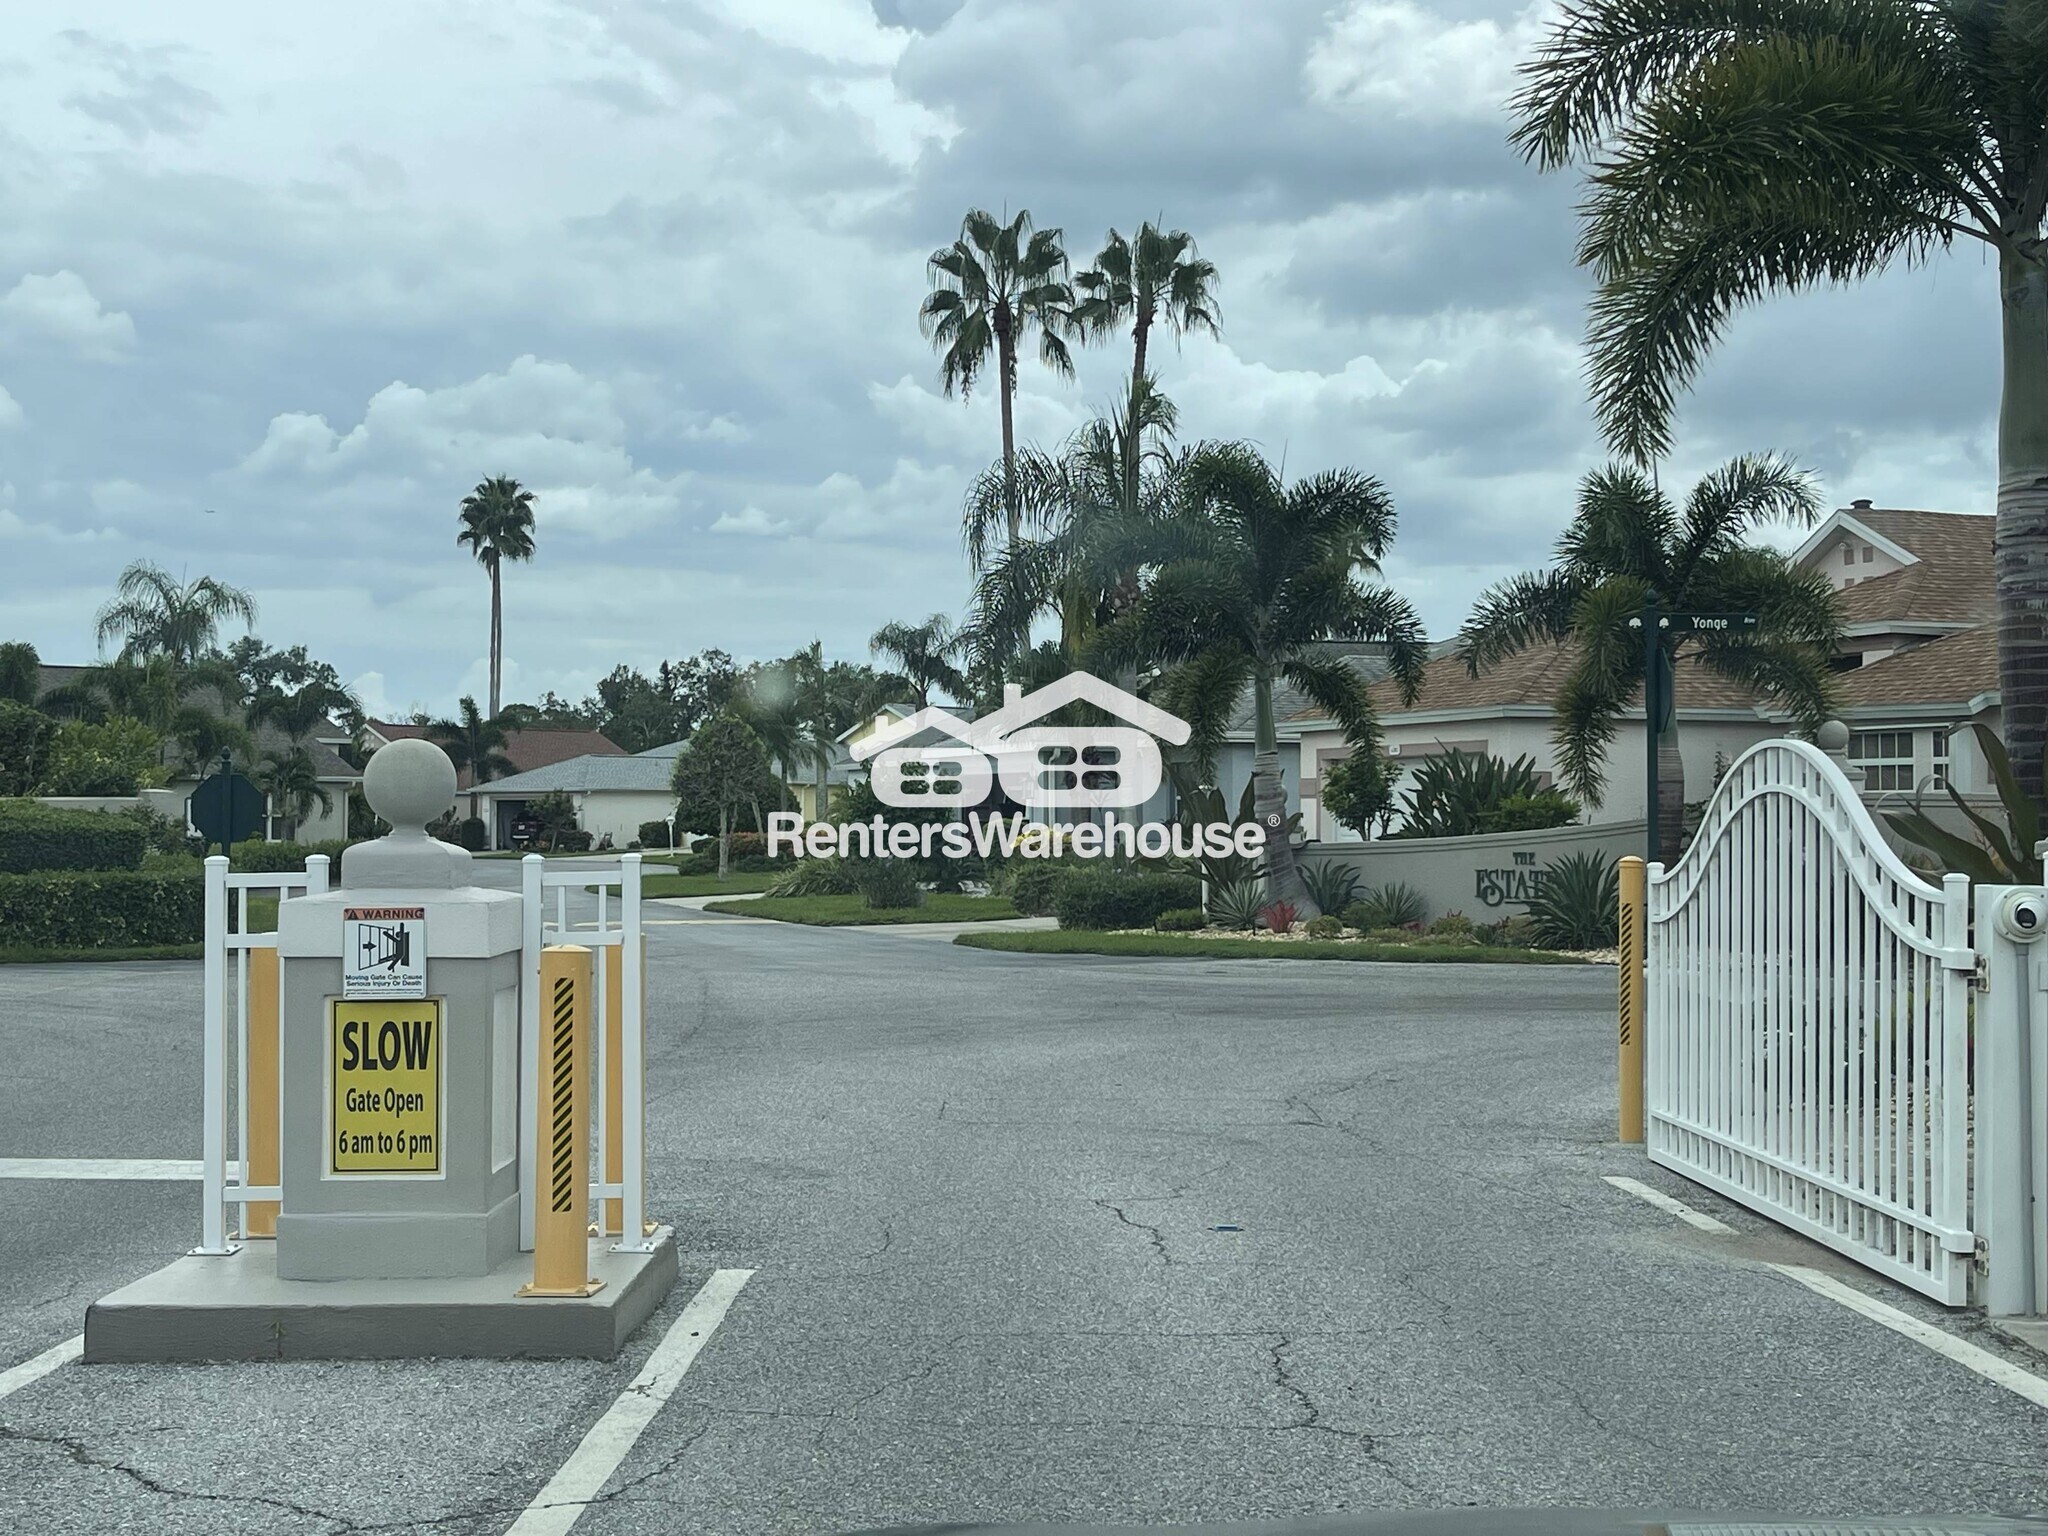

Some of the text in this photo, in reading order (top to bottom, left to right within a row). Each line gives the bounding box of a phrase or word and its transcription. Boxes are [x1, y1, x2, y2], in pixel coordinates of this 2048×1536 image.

[1691, 616, 1728, 631] Yonge
[1512, 851, 1536, 866] THE
[363, 909, 423, 919] WARNING
[342, 1020, 433, 1071] SLOW
[346, 1087, 424, 1119] Gate Open
[339, 1129, 433, 1160] 6 am to 6 pm
